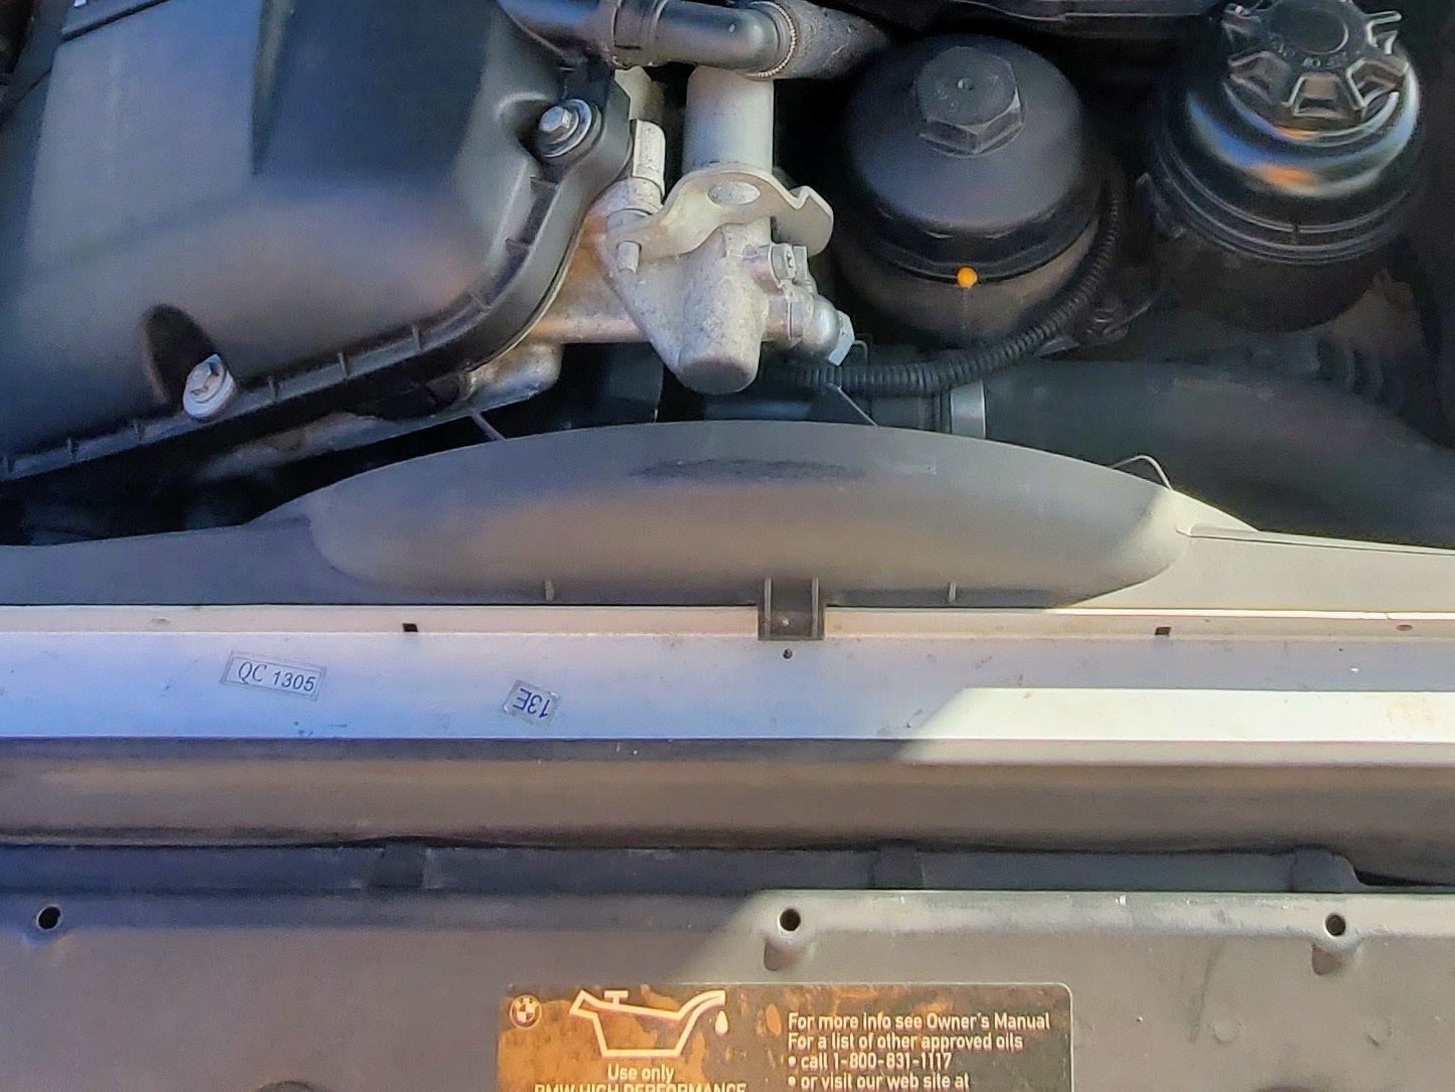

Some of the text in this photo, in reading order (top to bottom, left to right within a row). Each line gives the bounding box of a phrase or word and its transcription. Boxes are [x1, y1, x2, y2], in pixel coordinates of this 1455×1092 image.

[238, 661, 316, 691] QC 1305
[513, 688, 550, 718] 13E
[788, 1012, 1050, 1030] For more info see Owner's Manual
[788, 1032, 1023, 1054] For a list of other approved oils
[801, 1052, 952, 1070] call 1-800-831-1117
[607, 1063, 674, 1084] Use only
[801, 1072, 969, 1090] or visit our web site at
